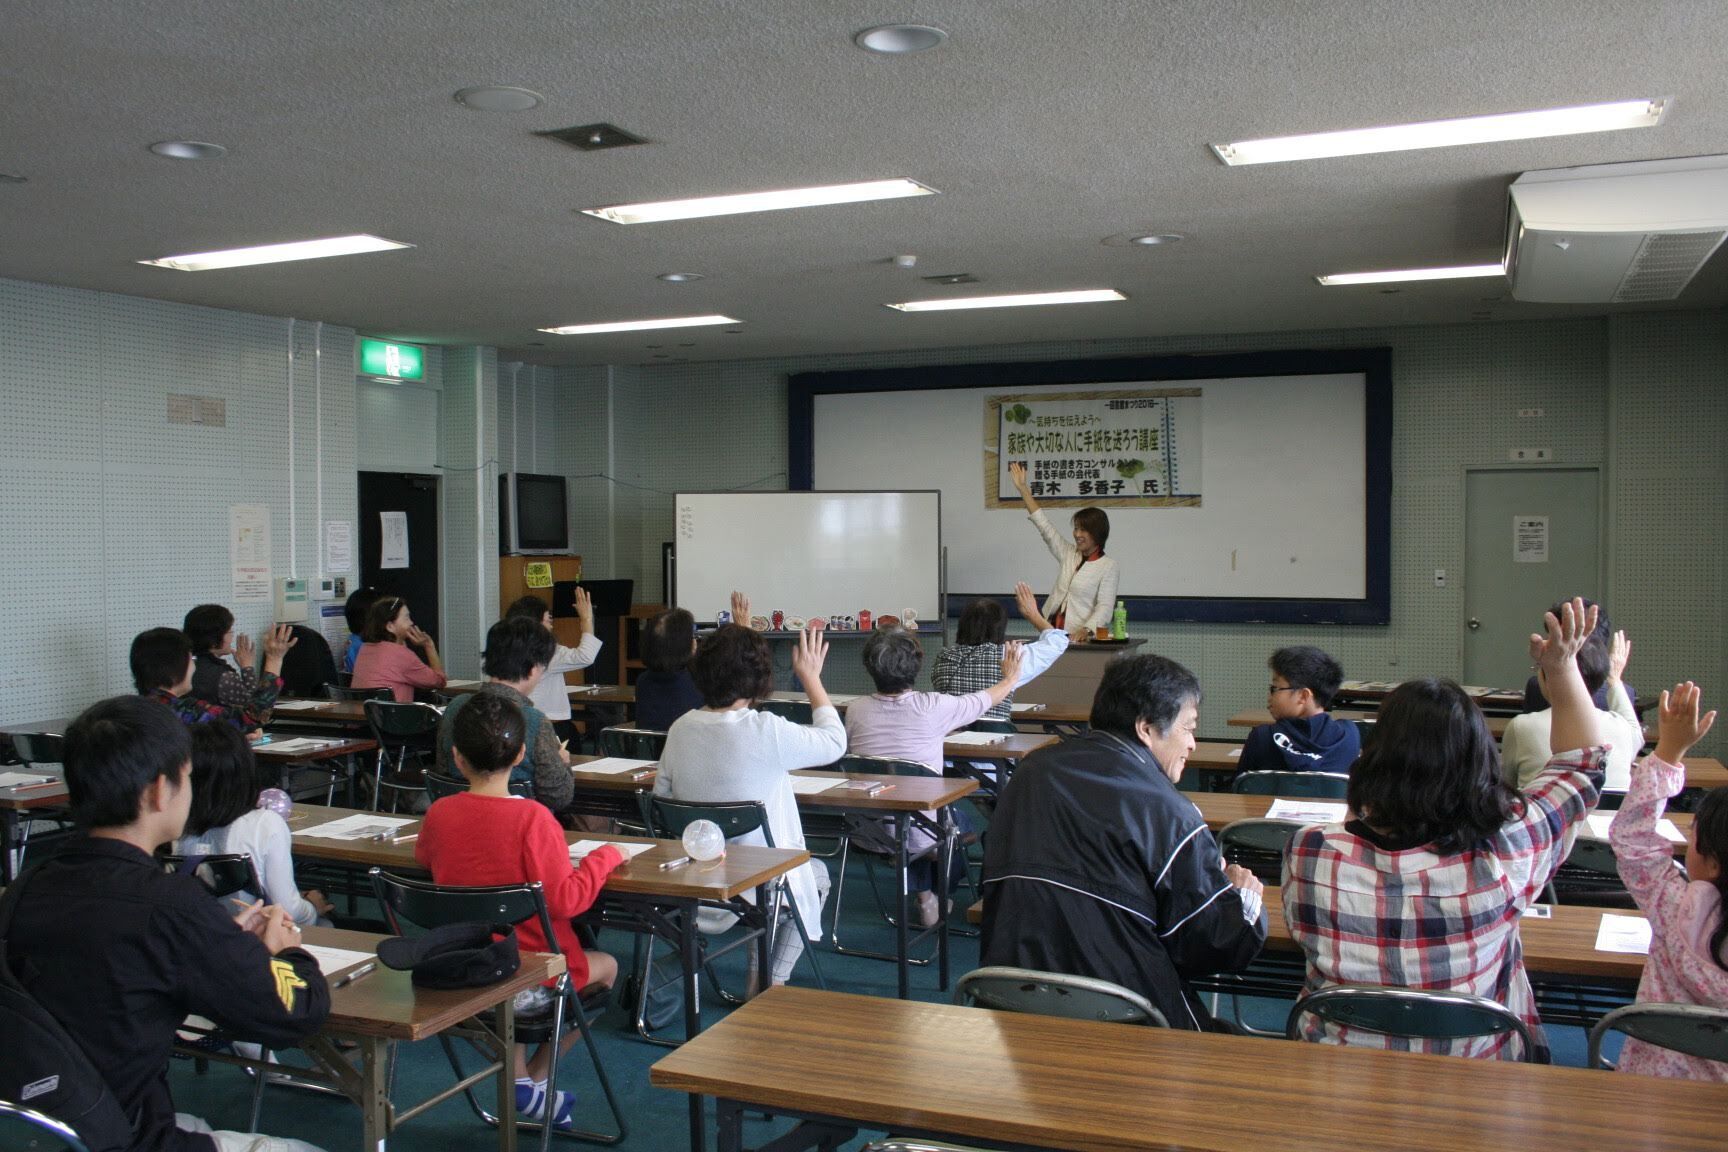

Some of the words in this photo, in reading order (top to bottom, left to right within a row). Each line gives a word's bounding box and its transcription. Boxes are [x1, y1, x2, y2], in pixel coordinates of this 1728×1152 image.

[1008, 427, 1159, 455] 家族や大切な人に手紙を送ろう講座
[1143, 479, 1159, 494] 氏
